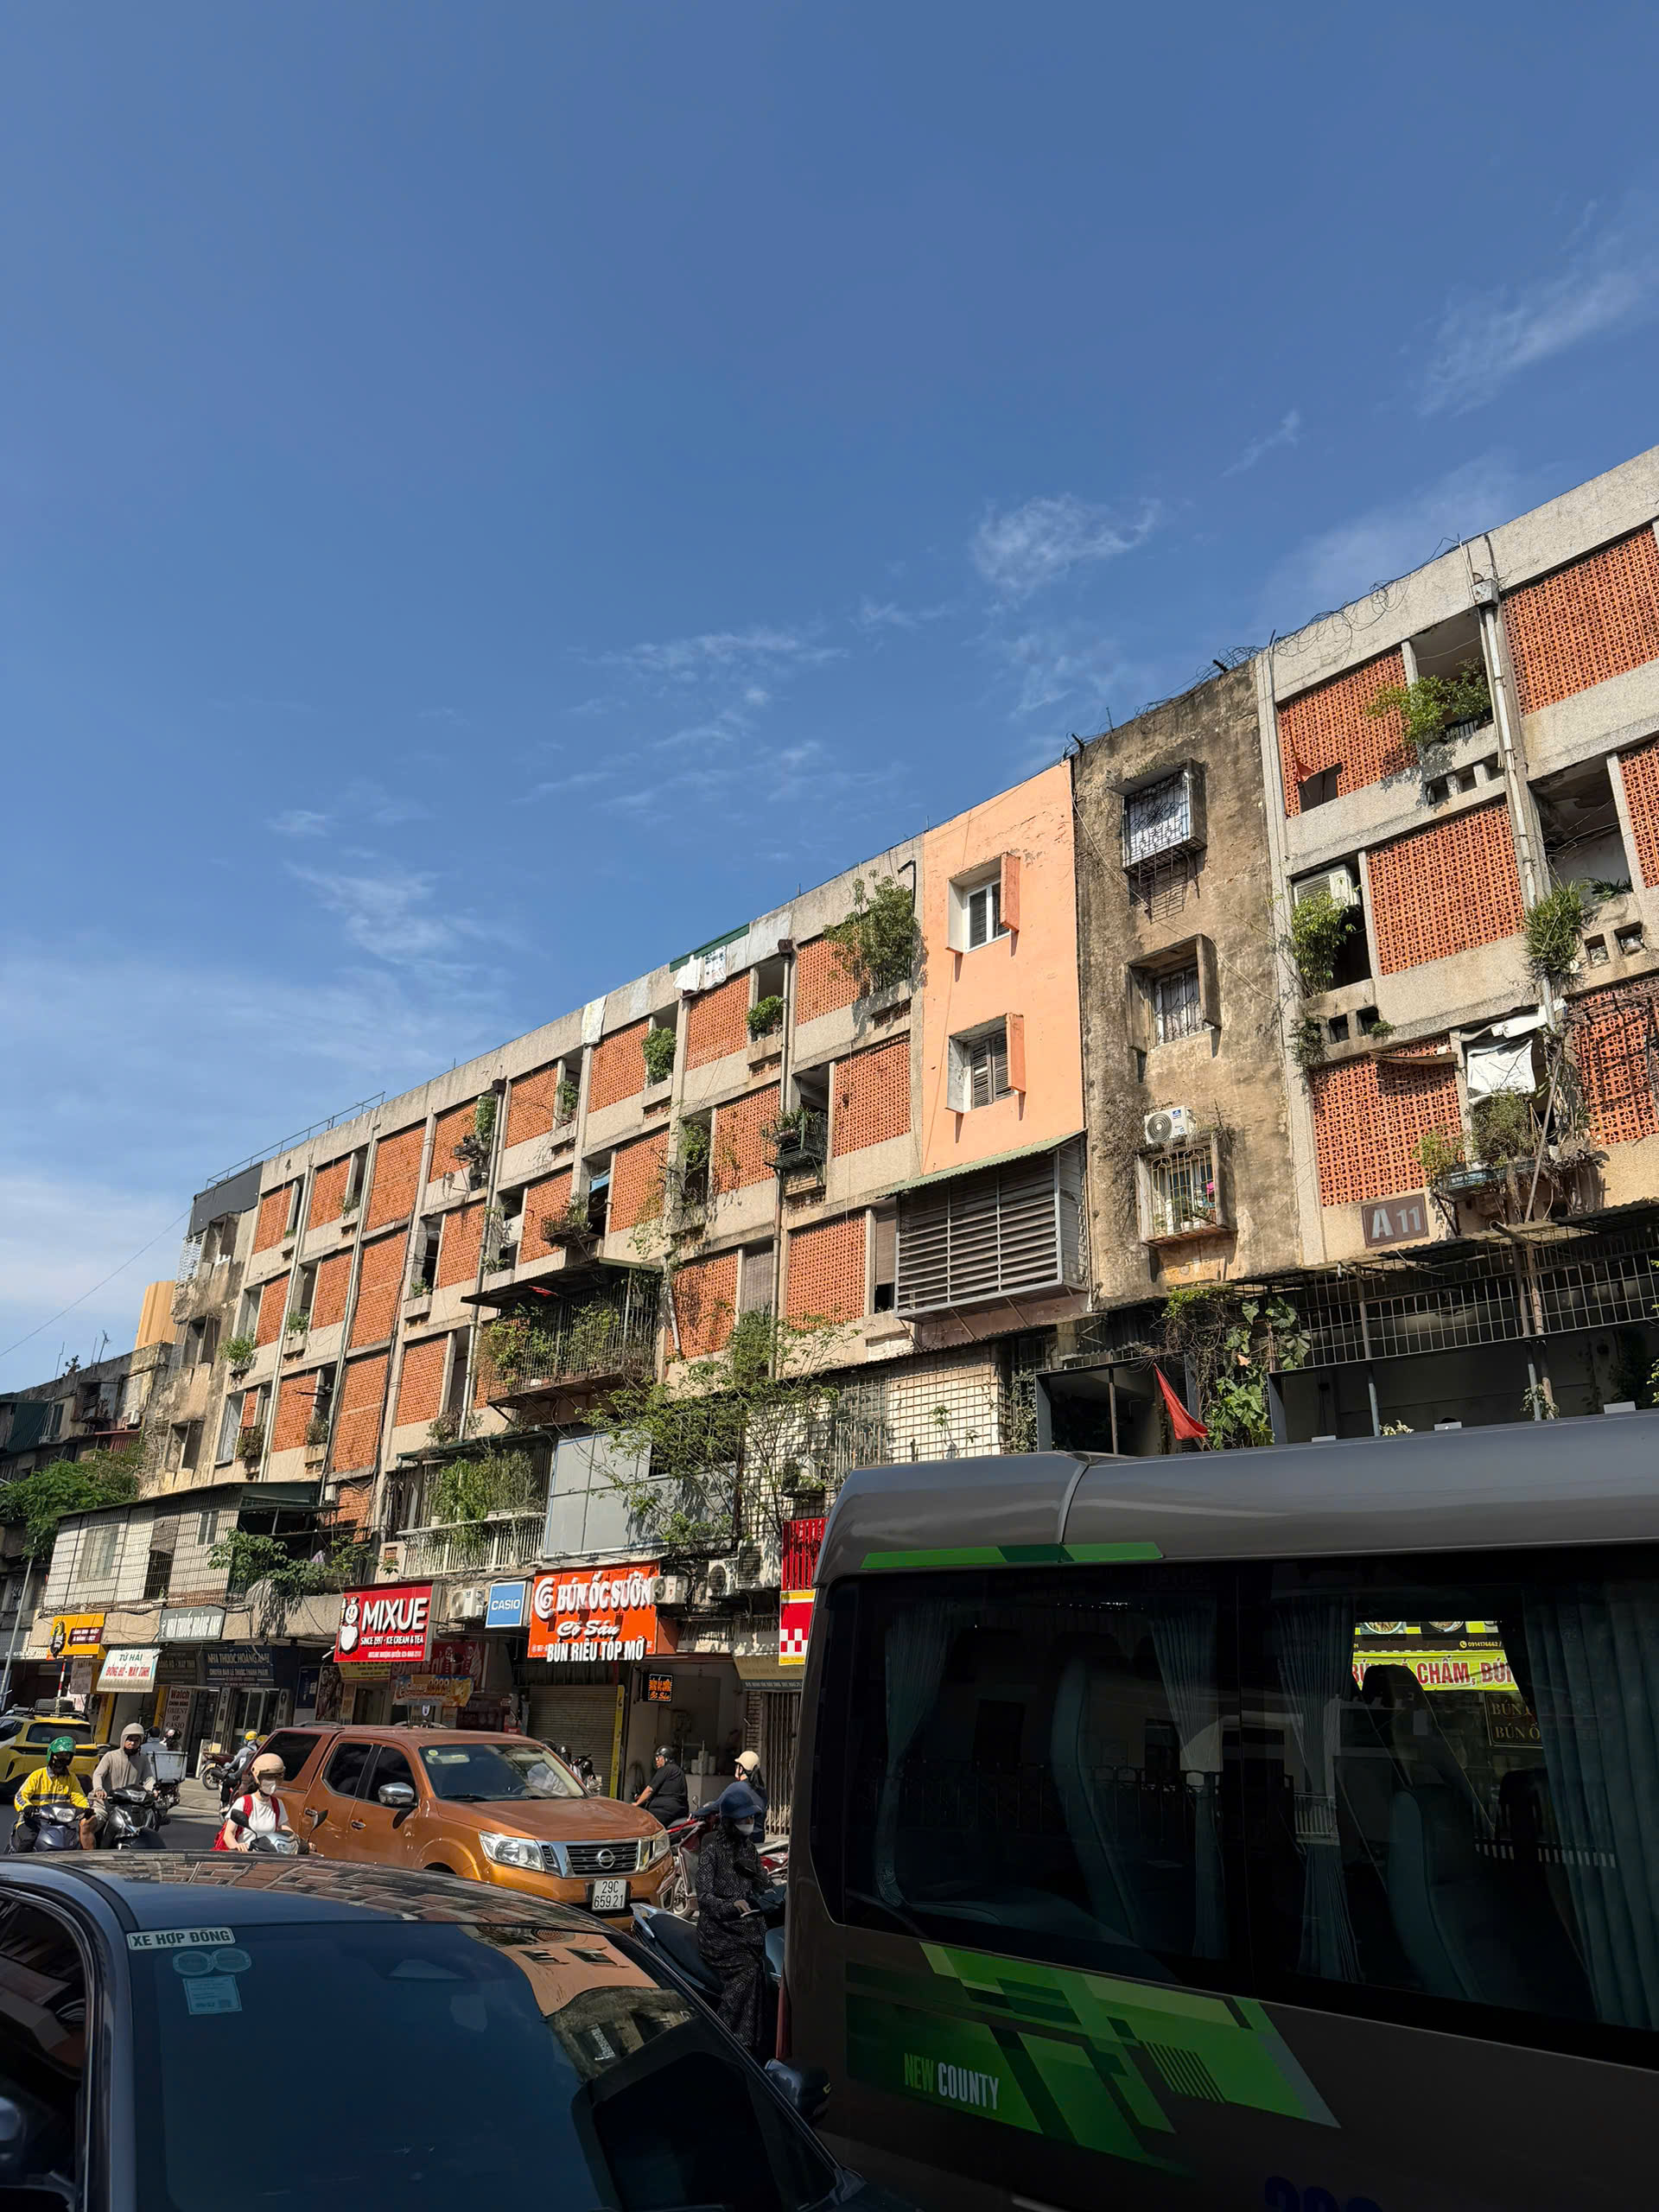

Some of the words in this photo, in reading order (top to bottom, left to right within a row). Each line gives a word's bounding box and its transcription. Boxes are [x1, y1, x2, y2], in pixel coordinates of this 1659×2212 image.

[556, 1577, 589, 1611] BÚN
[588, 1571, 611, 1609] ỐC
[491, 1599, 520, 1611] CASIO
[361, 1597, 428, 1631] MIXUE
[557, 1621, 582, 1637] Cô
[584, 1620, 620, 1637] Sáu
[414, 1635, 424, 1643] TEA
[547, 1638, 569, 1662] BÚN
[571, 1638, 597, 1662] RIÊU
[601, 1637, 623, 1661] TÓP
[624, 1636, 645, 1661] MỠ
[602, 1881, 619, 1893] 29C
[594, 1895, 623, 1908] 659.21
[132, 1935, 152, 1947] XE
[156, 1933, 185, 1946] HỢP
[189, 1929, 231, 1942] ĐỒNG
[905, 2053, 934, 2093] NEW
[938, 2063, 999, 2110] COUNTY
